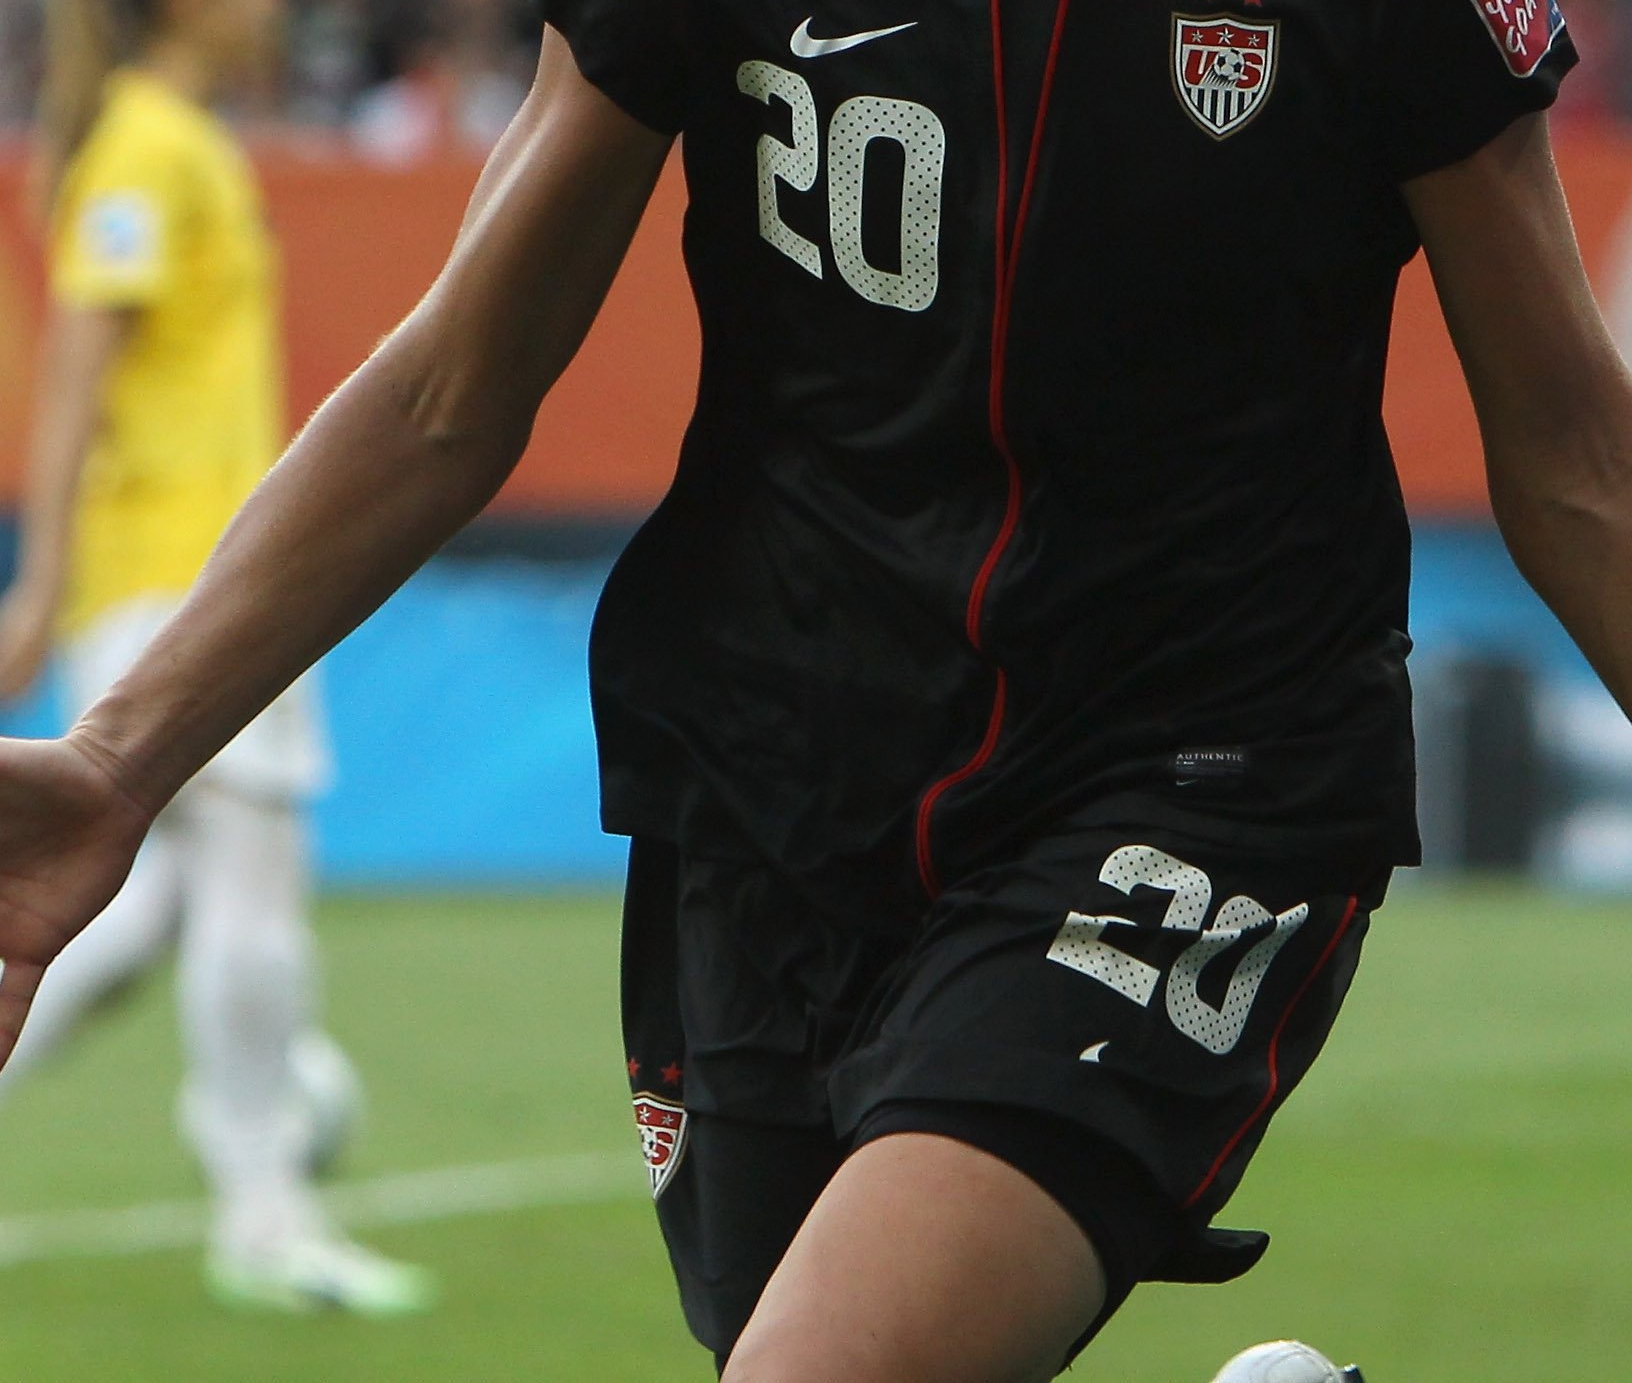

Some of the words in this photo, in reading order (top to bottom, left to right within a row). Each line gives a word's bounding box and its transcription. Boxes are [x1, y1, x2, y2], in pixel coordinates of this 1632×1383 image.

[736, 59, 945, 311] 20
[1176, 753, 1244, 761] AUTHENTIC
[1046, 844, 1309, 1055] 20
